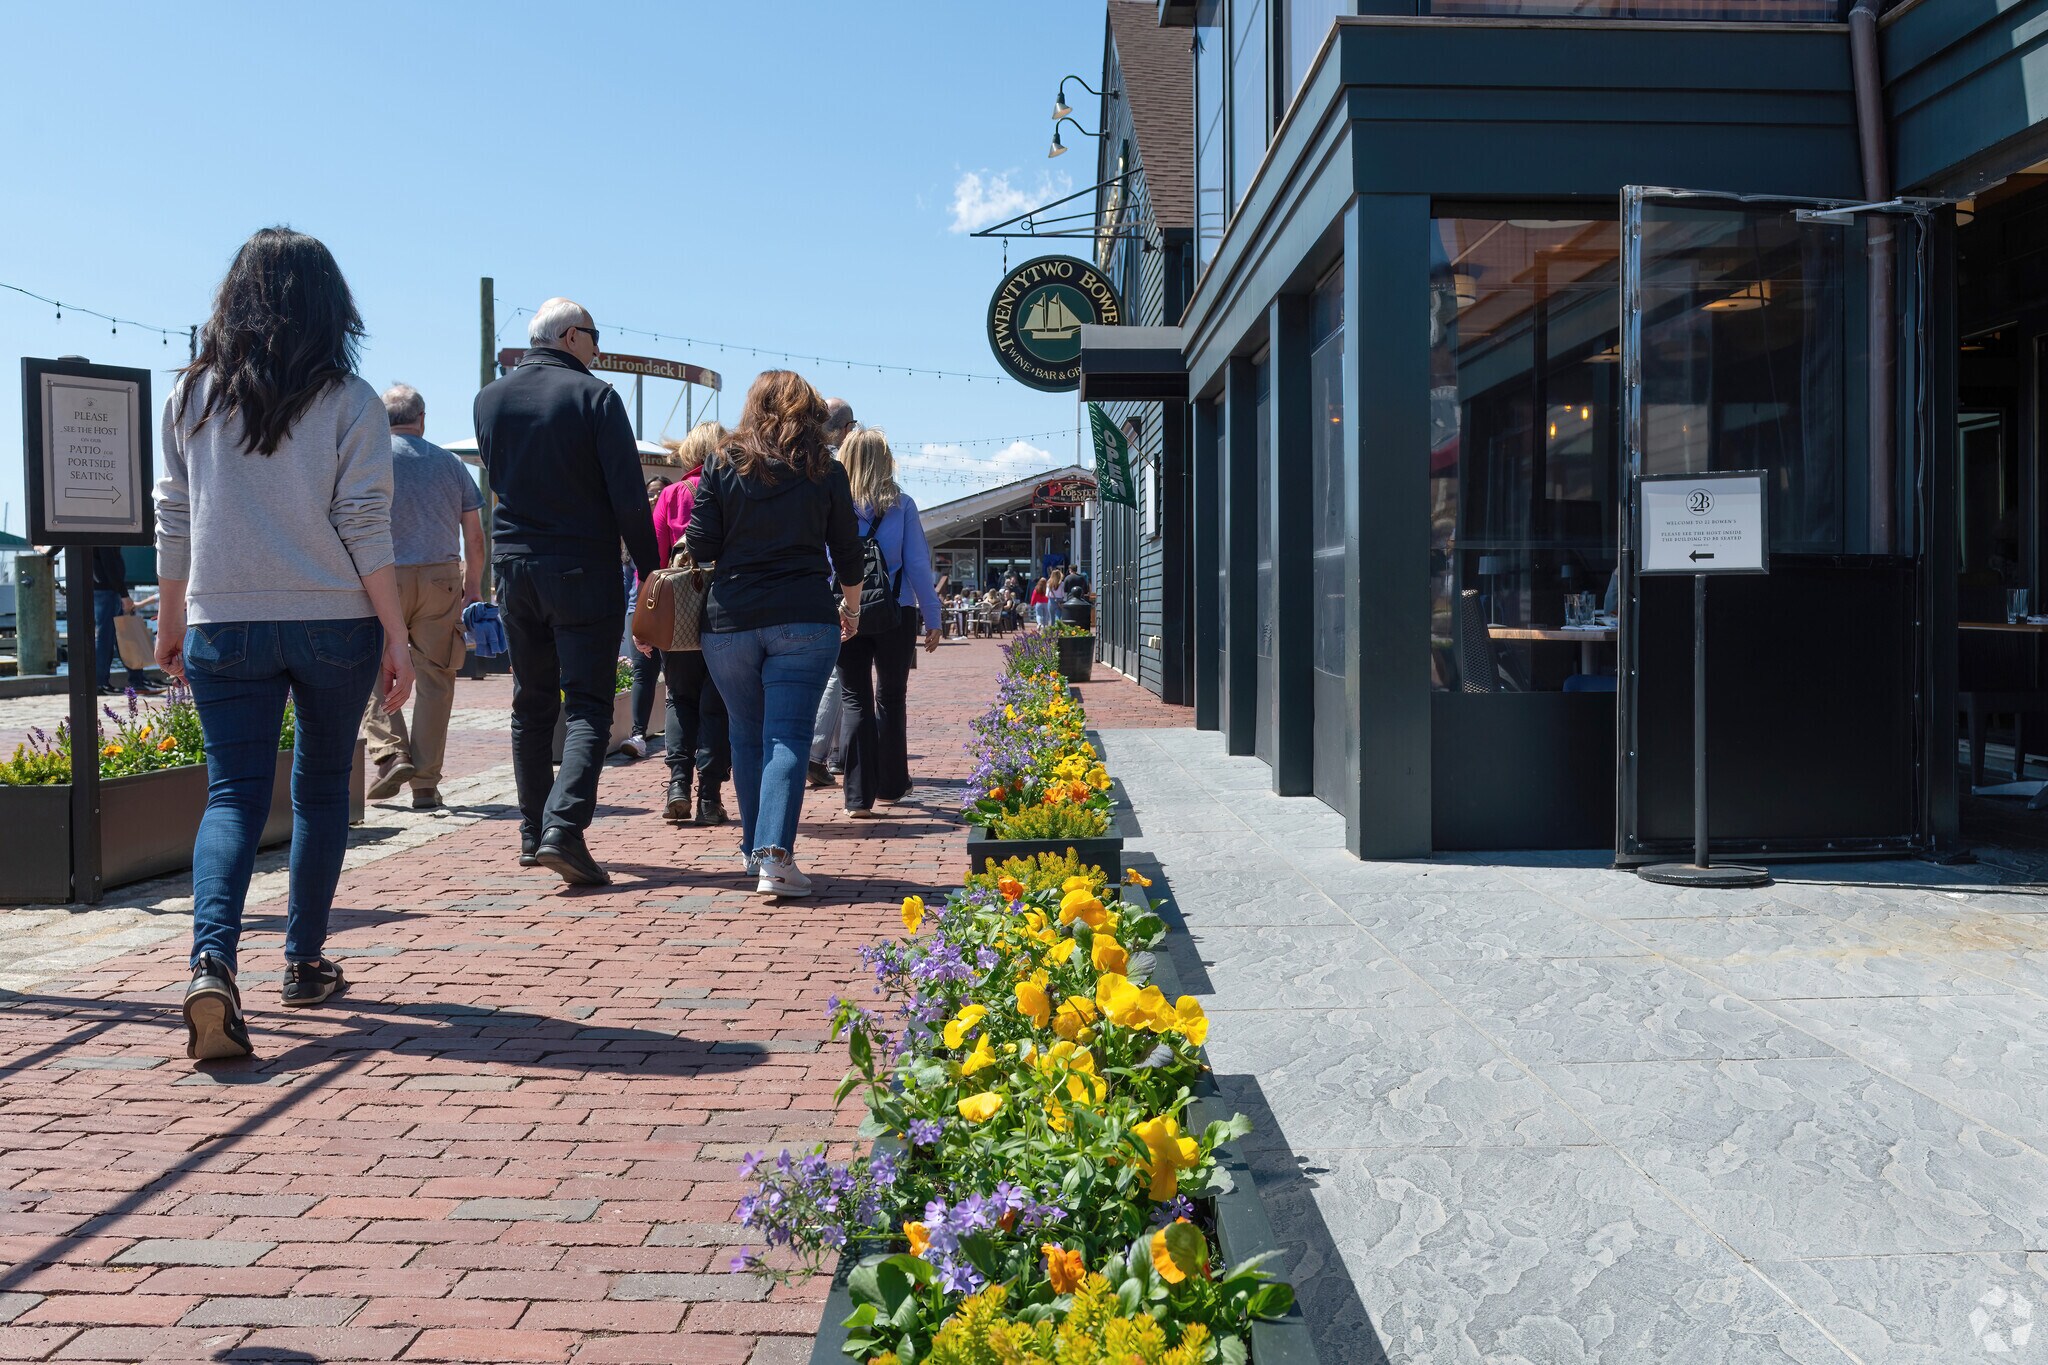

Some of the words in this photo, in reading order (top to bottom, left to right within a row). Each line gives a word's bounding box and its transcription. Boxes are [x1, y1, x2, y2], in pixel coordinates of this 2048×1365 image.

[995, 262, 1073, 351] TWENTYTWO
[1079, 271, 1118, 326] BOWE
[590, 355, 675, 378] Adirondack
[677, 364, 686, 379] II
[1008, 347, 1032, 372] WINE
[1035, 367, 1057, 379] BAR
[1058, 371, 1066, 380] &
[74, 411, 109, 422] PLEASE
[63, 425, 76, 433] SEE
[77, 426, 93, 434] THE
[94, 426, 118, 436] HOST
[69, 445, 101, 454] PATIO
[68, 457, 117, 469] PORTSIDE
[1103, 429, 1127, 498] OPEN
[70, 470, 114, 481] SEATING
